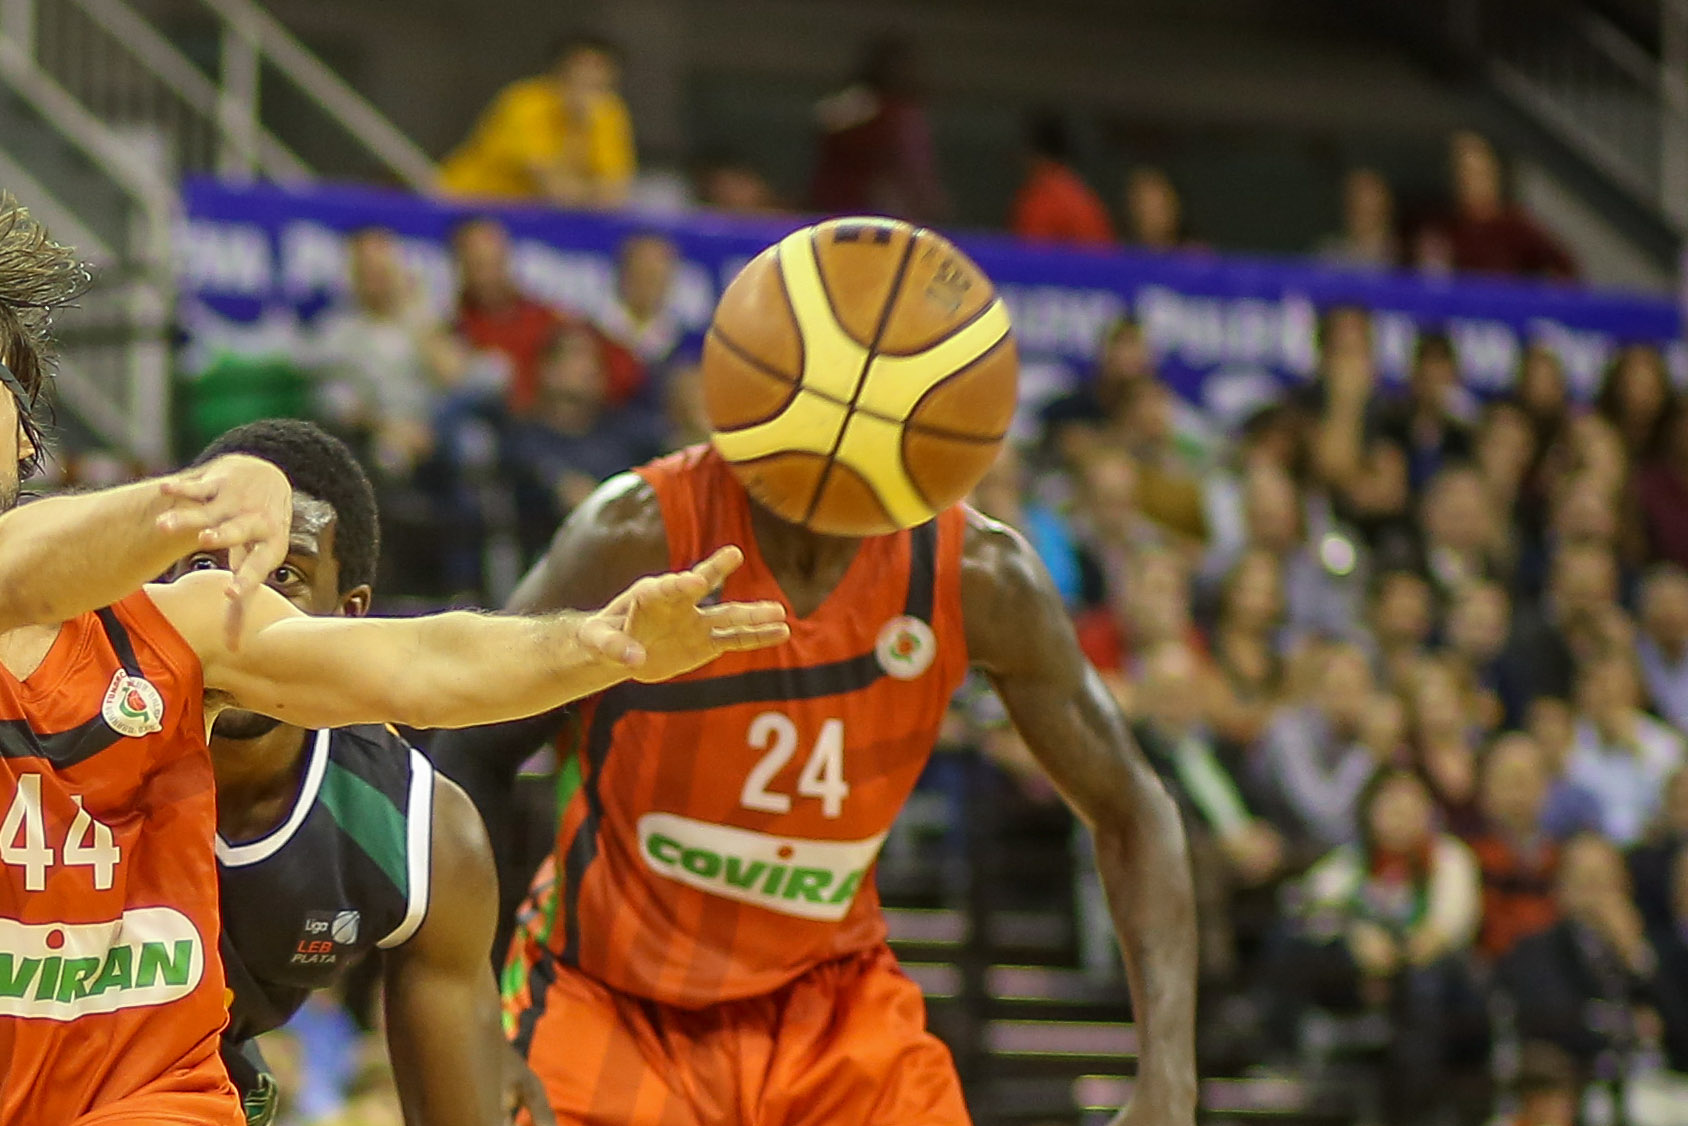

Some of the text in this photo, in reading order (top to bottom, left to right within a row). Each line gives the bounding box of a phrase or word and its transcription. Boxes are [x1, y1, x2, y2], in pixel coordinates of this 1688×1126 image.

[740, 711, 850, 819] 24
[297, 940, 334, 954] LEB
[290, 953, 337, 964] PLATA
